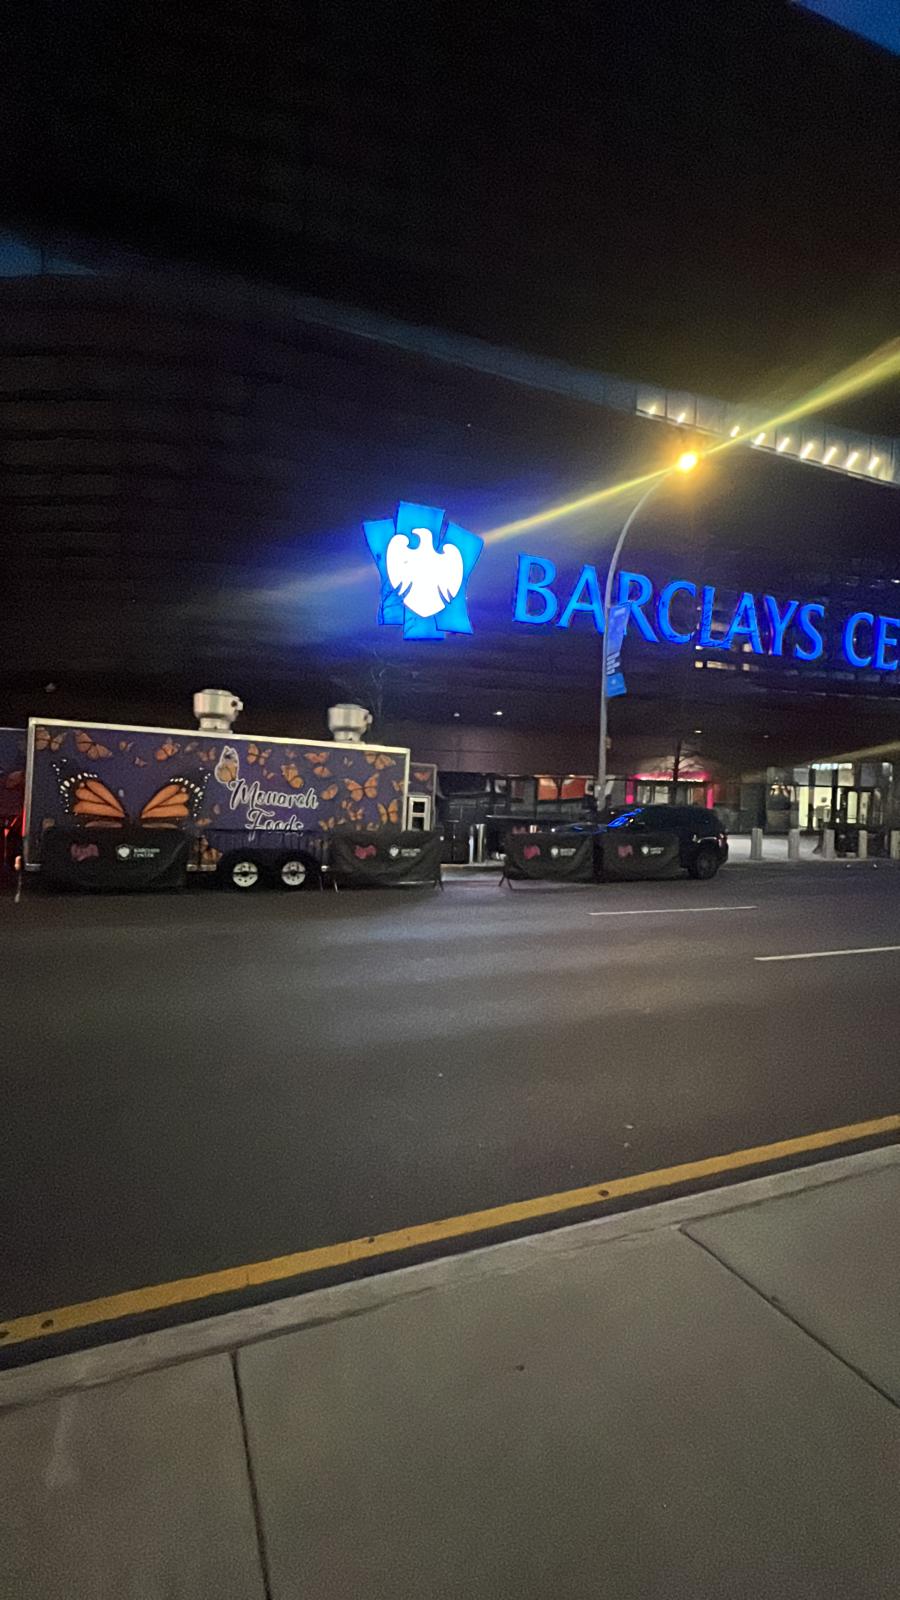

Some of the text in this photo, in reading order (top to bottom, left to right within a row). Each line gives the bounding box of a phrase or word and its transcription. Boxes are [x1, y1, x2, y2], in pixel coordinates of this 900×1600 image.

[512, 553, 825, 661] BARCLAYS
[226, 778, 319, 810] Monarch
[245, 808, 304, 841] Foods
